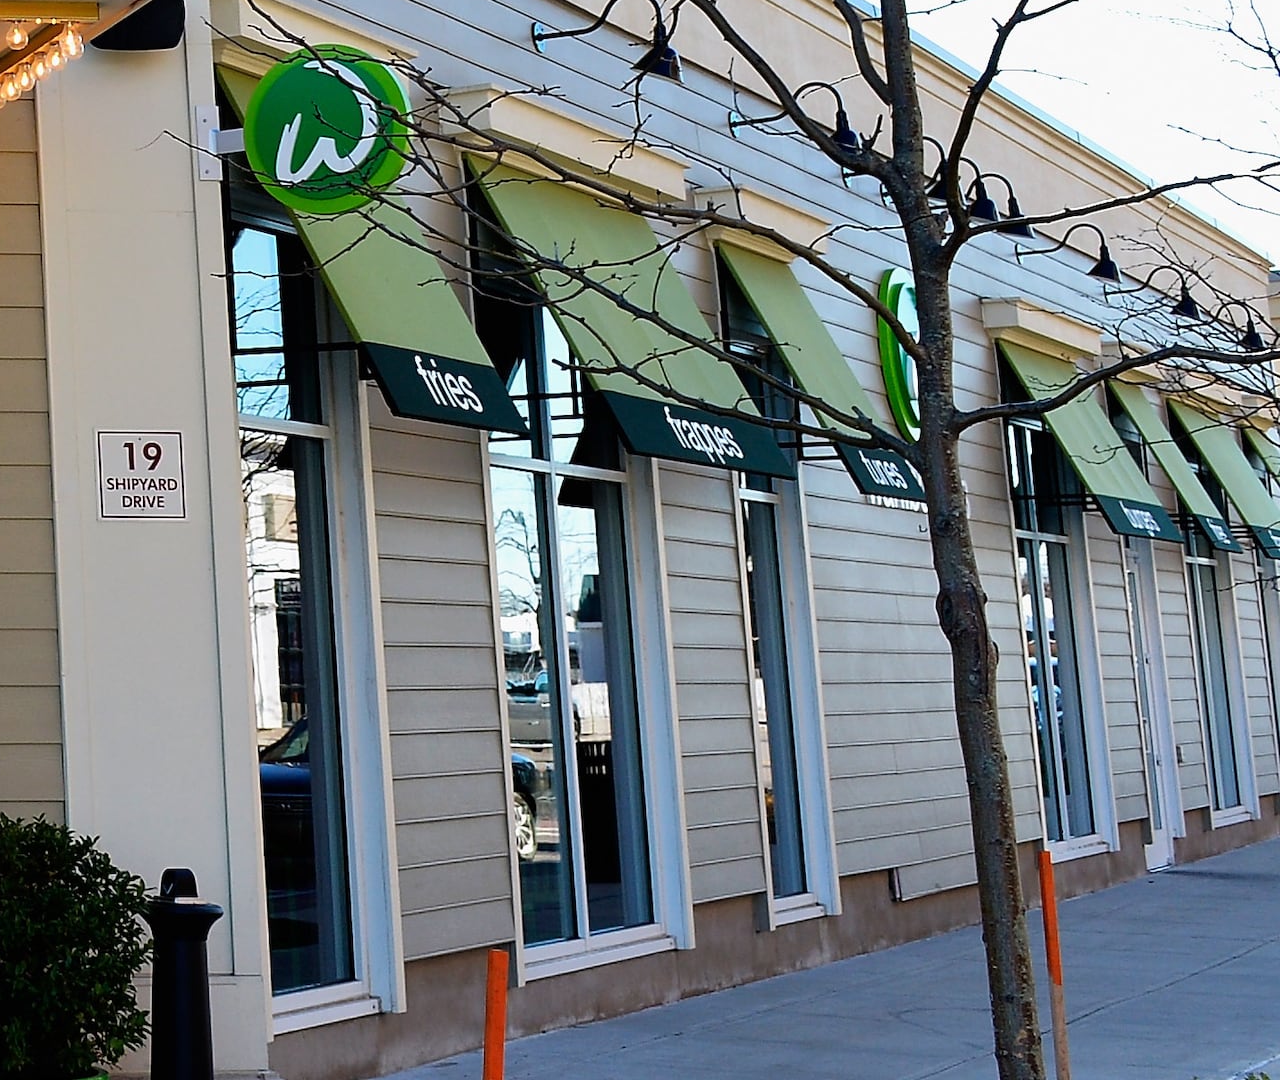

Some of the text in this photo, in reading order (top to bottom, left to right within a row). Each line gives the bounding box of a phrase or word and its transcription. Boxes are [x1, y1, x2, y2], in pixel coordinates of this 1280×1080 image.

[414, 354, 484, 413] fries
[663, 405, 744, 465] frappes
[122, 441, 163, 471] 19
[858, 449, 909, 490] tunes
[106, 477, 178, 491] SHIPYARD
[121, 495, 165, 508] DRIVE
